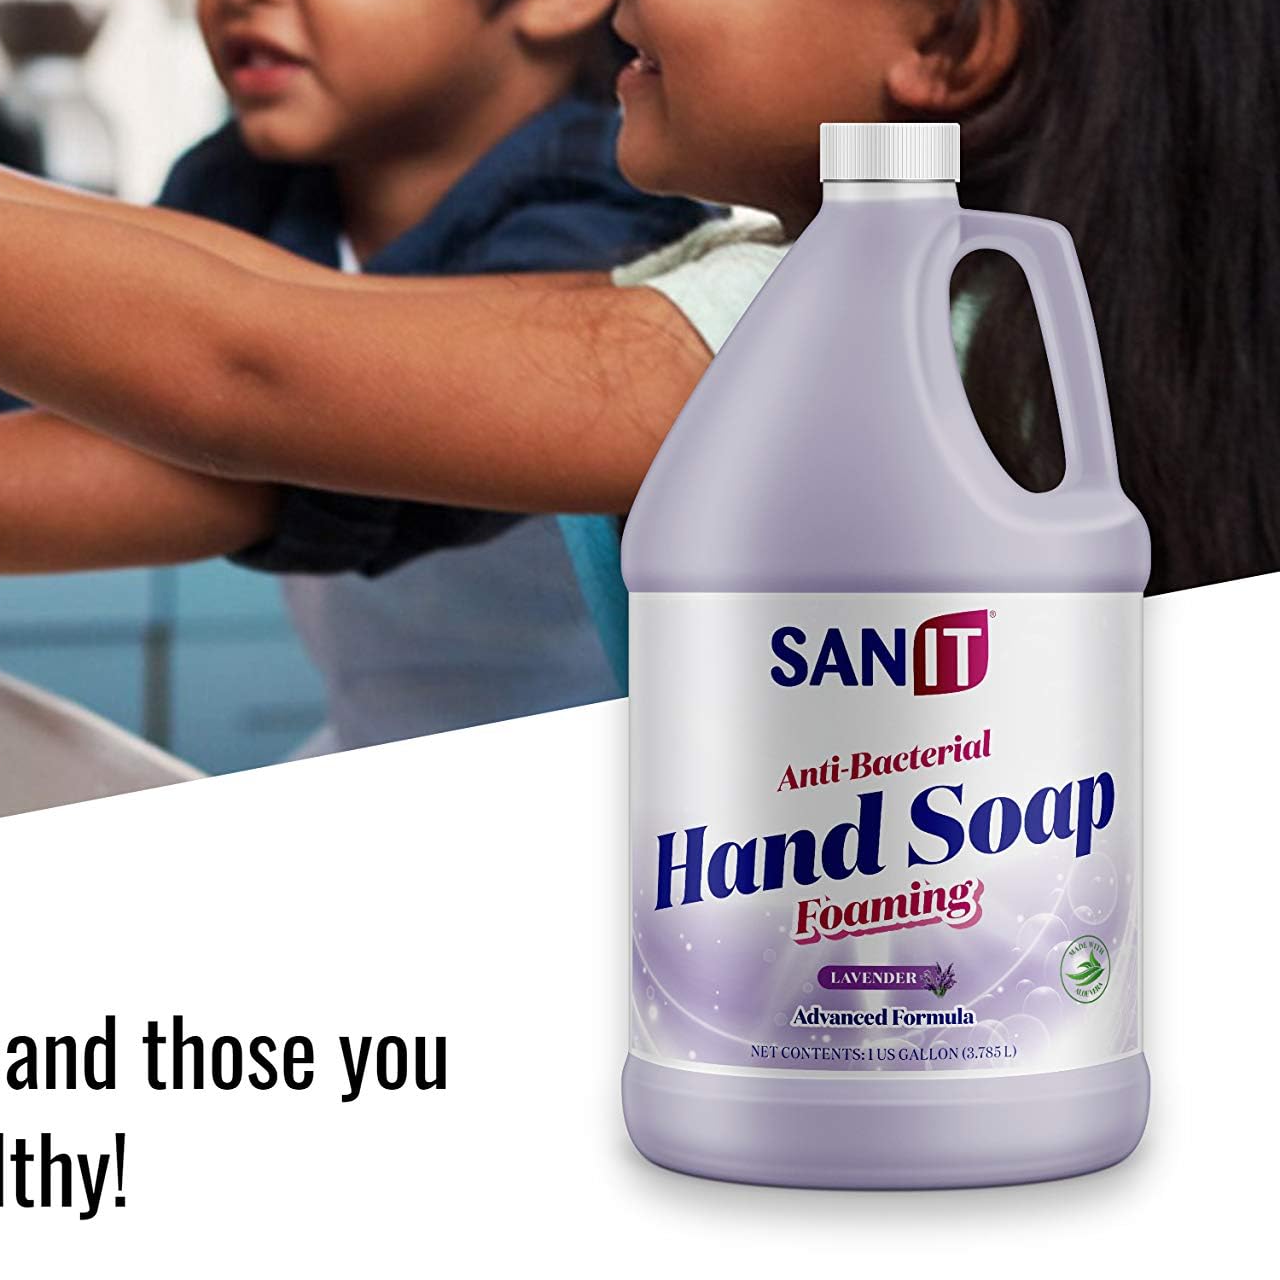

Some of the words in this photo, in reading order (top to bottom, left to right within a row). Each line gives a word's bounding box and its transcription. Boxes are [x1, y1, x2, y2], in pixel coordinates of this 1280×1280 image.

[776, 729, 992, 793] Anti-Bacterial
[654, 791, 886, 912] Hand
[907, 771, 1116, 867] Soap
[796, 879, 975, 936] Foaming
[830, 971, 918, 985] LAVENDER
[793, 1007, 888, 1026] Advanced
[892, 1007, 974, 1026] Formula
[751, 1045, 778, 1058] NET
[781, 1047, 866, 1061] CONTENTS:
[876, 1048, 895, 1061] US
[898, 1047, 959, 1061] GALLON
